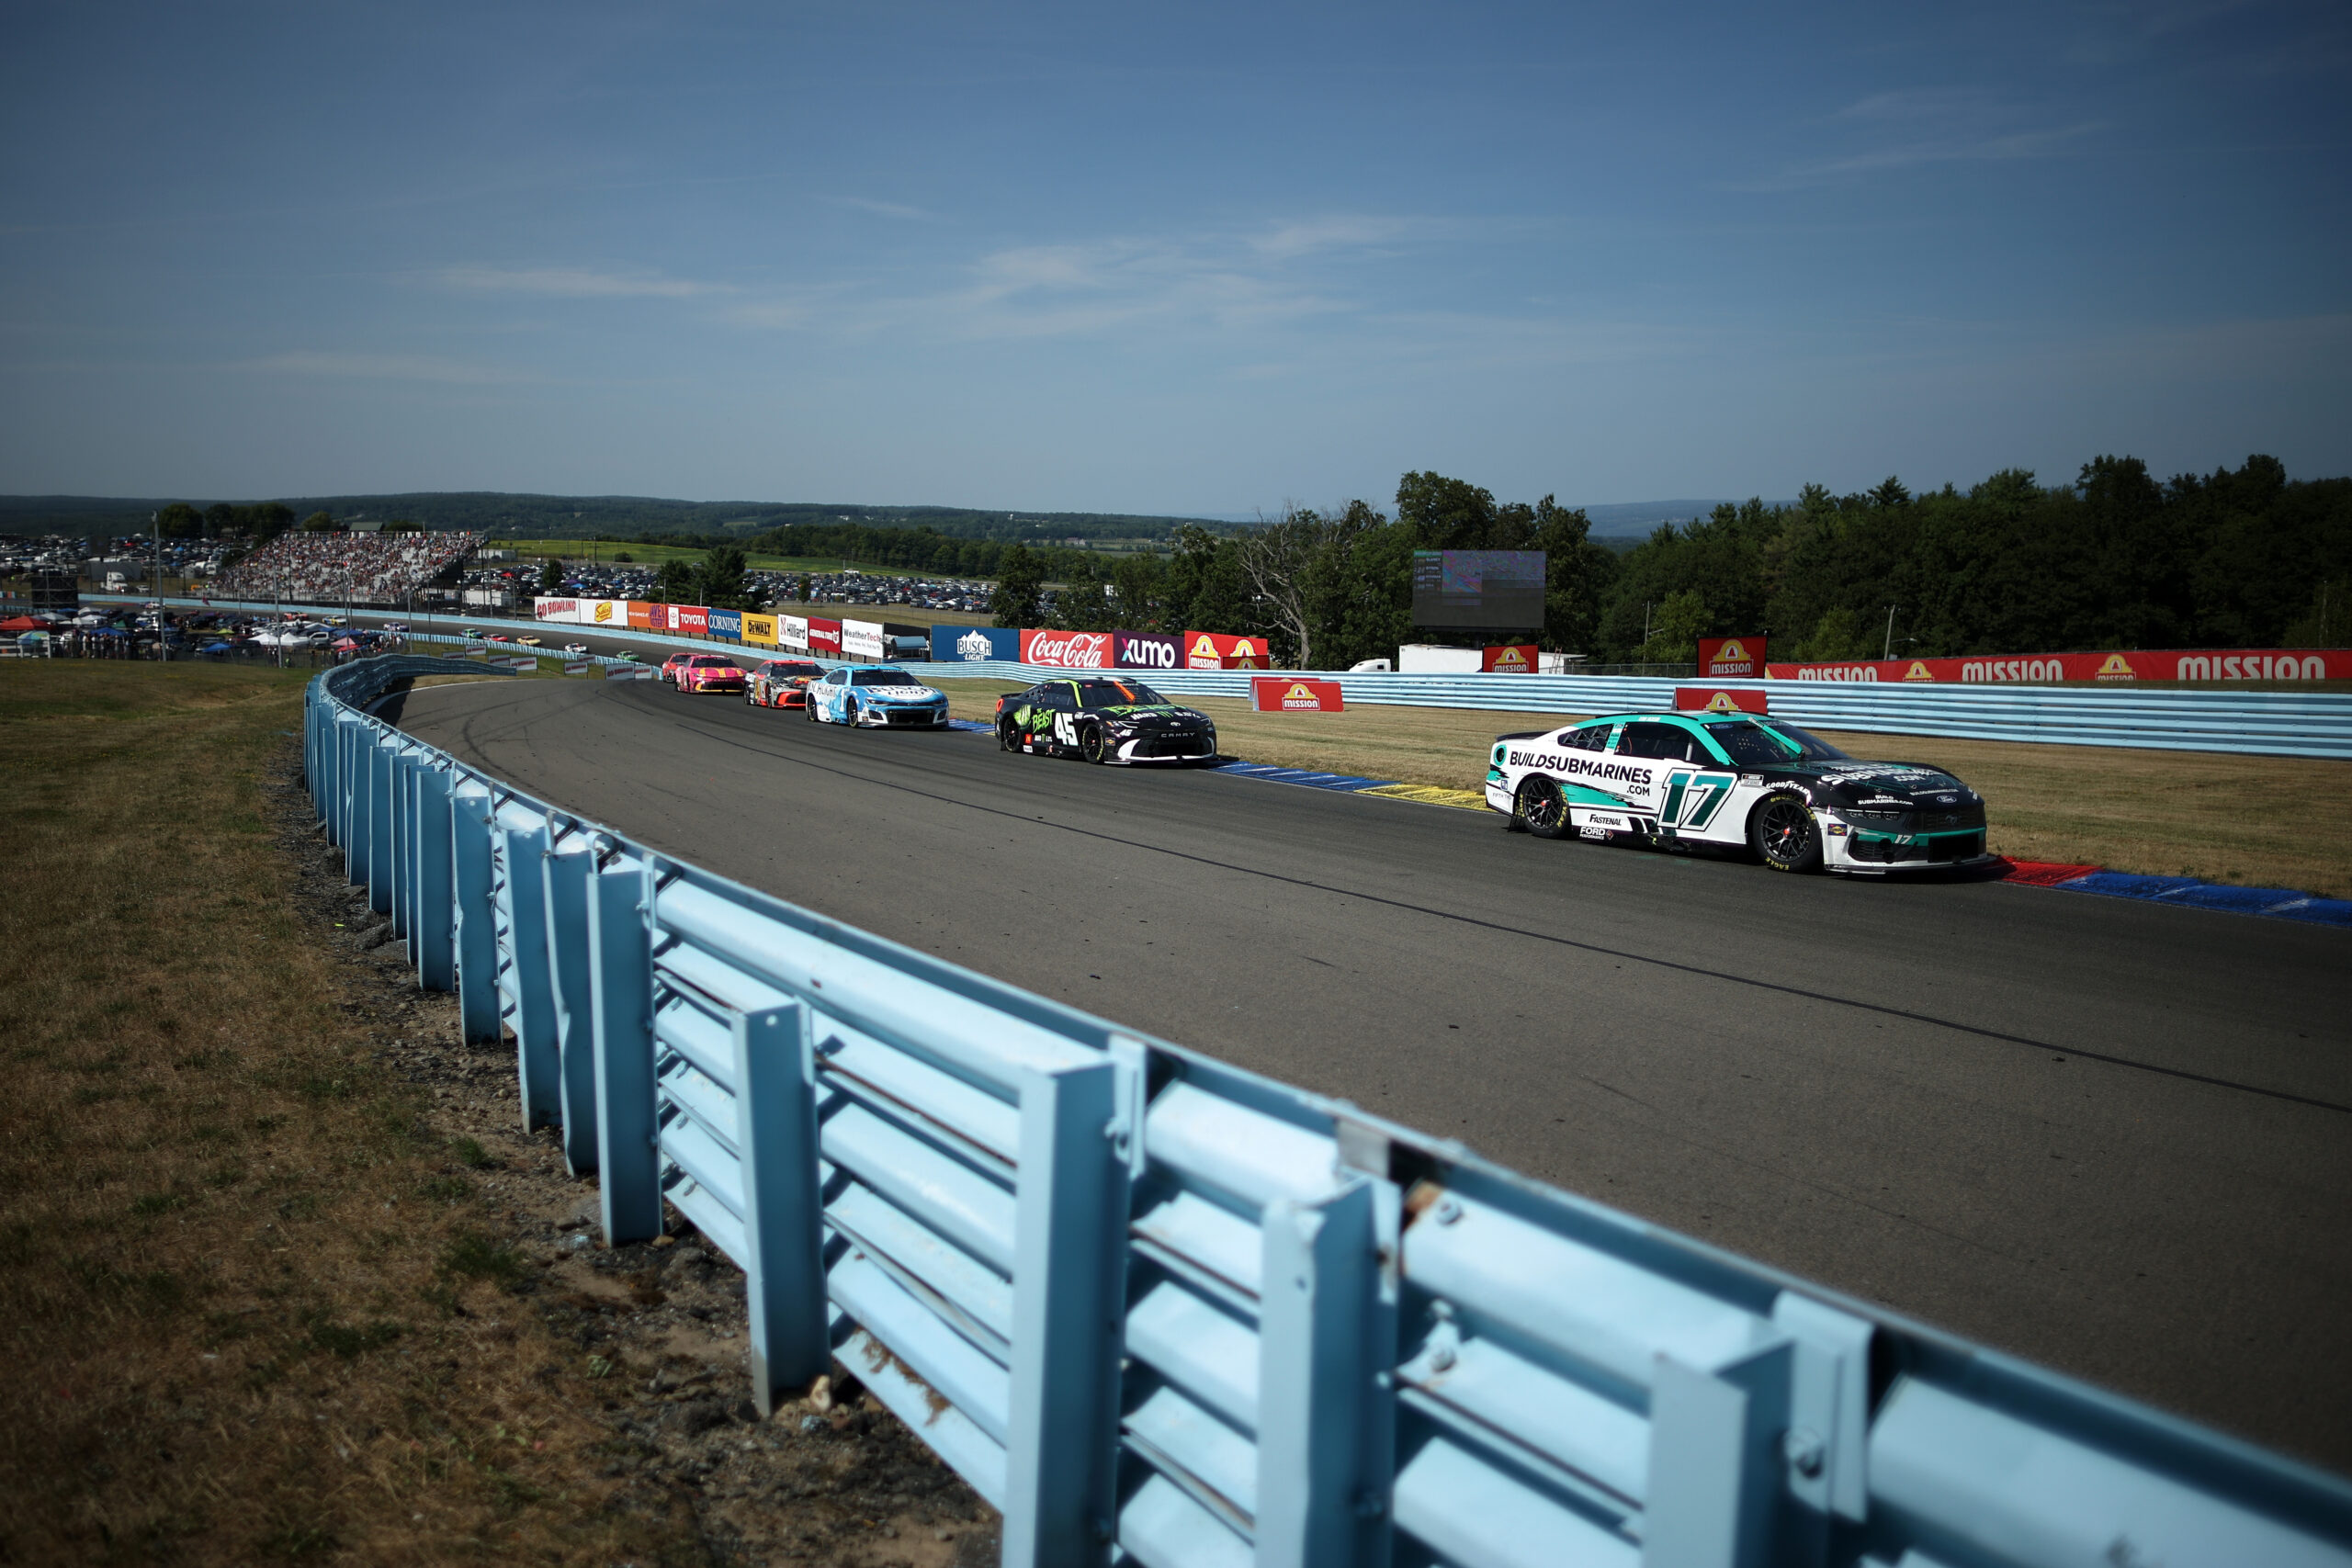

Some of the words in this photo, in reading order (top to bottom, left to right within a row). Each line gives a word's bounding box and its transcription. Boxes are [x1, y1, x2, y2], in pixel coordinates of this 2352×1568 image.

[537, 604, 547, 618] GO
[548, 600, 576, 615] BOWLING
[680, 614, 707, 626] TOYOTA
[708, 615, 741, 633] CORNING
[786, 623, 806, 640] Hilliard
[843, 627, 881, 643] WeatherTech
[957, 638, 992, 655] BUSCH
[1028, 631, 1107, 668] Coca-Cola
[1190, 657, 1220, 670] MISSION
[1494, 663, 1527, 673] MISSION
[1711, 662, 1752, 675] MISSION
[1962, 660, 2064, 682] MISSION
[2177, 656, 2325, 680] MISSION
[1798, 666, 1878, 682] MISSION
[1284, 699, 1318, 709] MISSION
[1032, 708, 1057, 734] BEAST
[1055, 712, 1079, 746] 45
[1510, 750, 1653, 785] BUILDSUBMARINES
[1626, 784, 1650, 796] .COM
[1766, 781, 1812, 805] GOODYEAR
[1657, 767, 1738, 832] 17
[1580, 827, 1606, 836] FORD
[1894, 834, 1912, 845] 17
[1765, 857, 1790, 870] EAGLE
